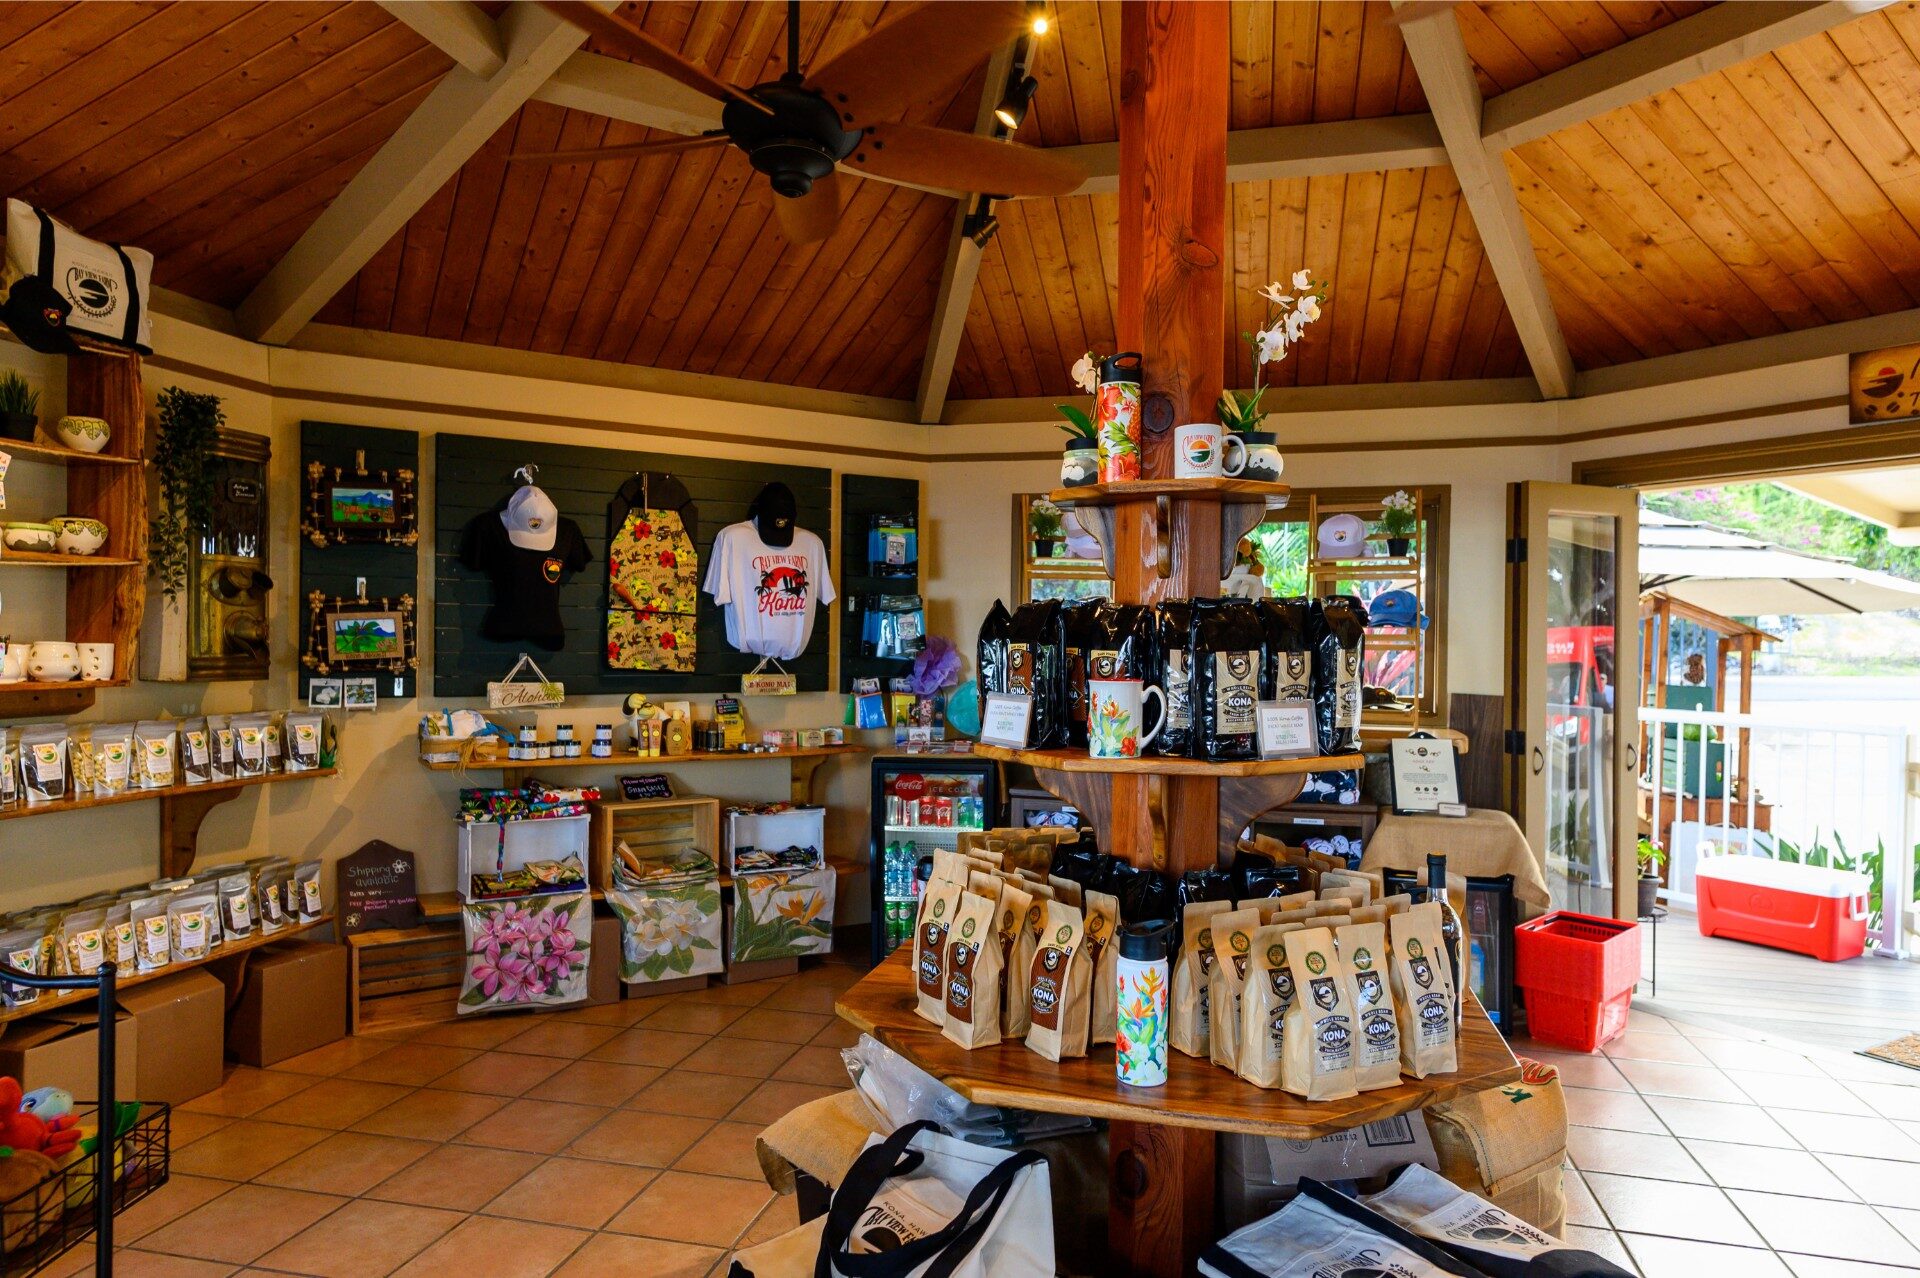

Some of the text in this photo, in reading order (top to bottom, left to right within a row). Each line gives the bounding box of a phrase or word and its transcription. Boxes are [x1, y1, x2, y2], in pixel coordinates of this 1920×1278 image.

[771, 555, 787, 564] VIEW
[786, 555, 806, 571] FARM
[758, 591, 806, 617] Kona
[502, 688, 553, 706] Aloha
[1228, 697, 1252, 707] KONA
[347, 866, 392, 877] Shipping
[921, 960, 938, 975] KONA
[951, 981, 969, 997] KONA
[1033, 987, 1055, 1003] KONA
[1273, 1004, 1288, 1013] WHOL
[1423, 1005, 1445, 1019] KONA
[1322, 1029, 1347, 1042] KONA
[1368, 1022, 1391, 1035] KONA
[883, 1201, 928, 1236] KONA, HAW
[1458, 1203, 1483, 1221] HAWAII
[863, 1206, 909, 1235] BAY VIEW
